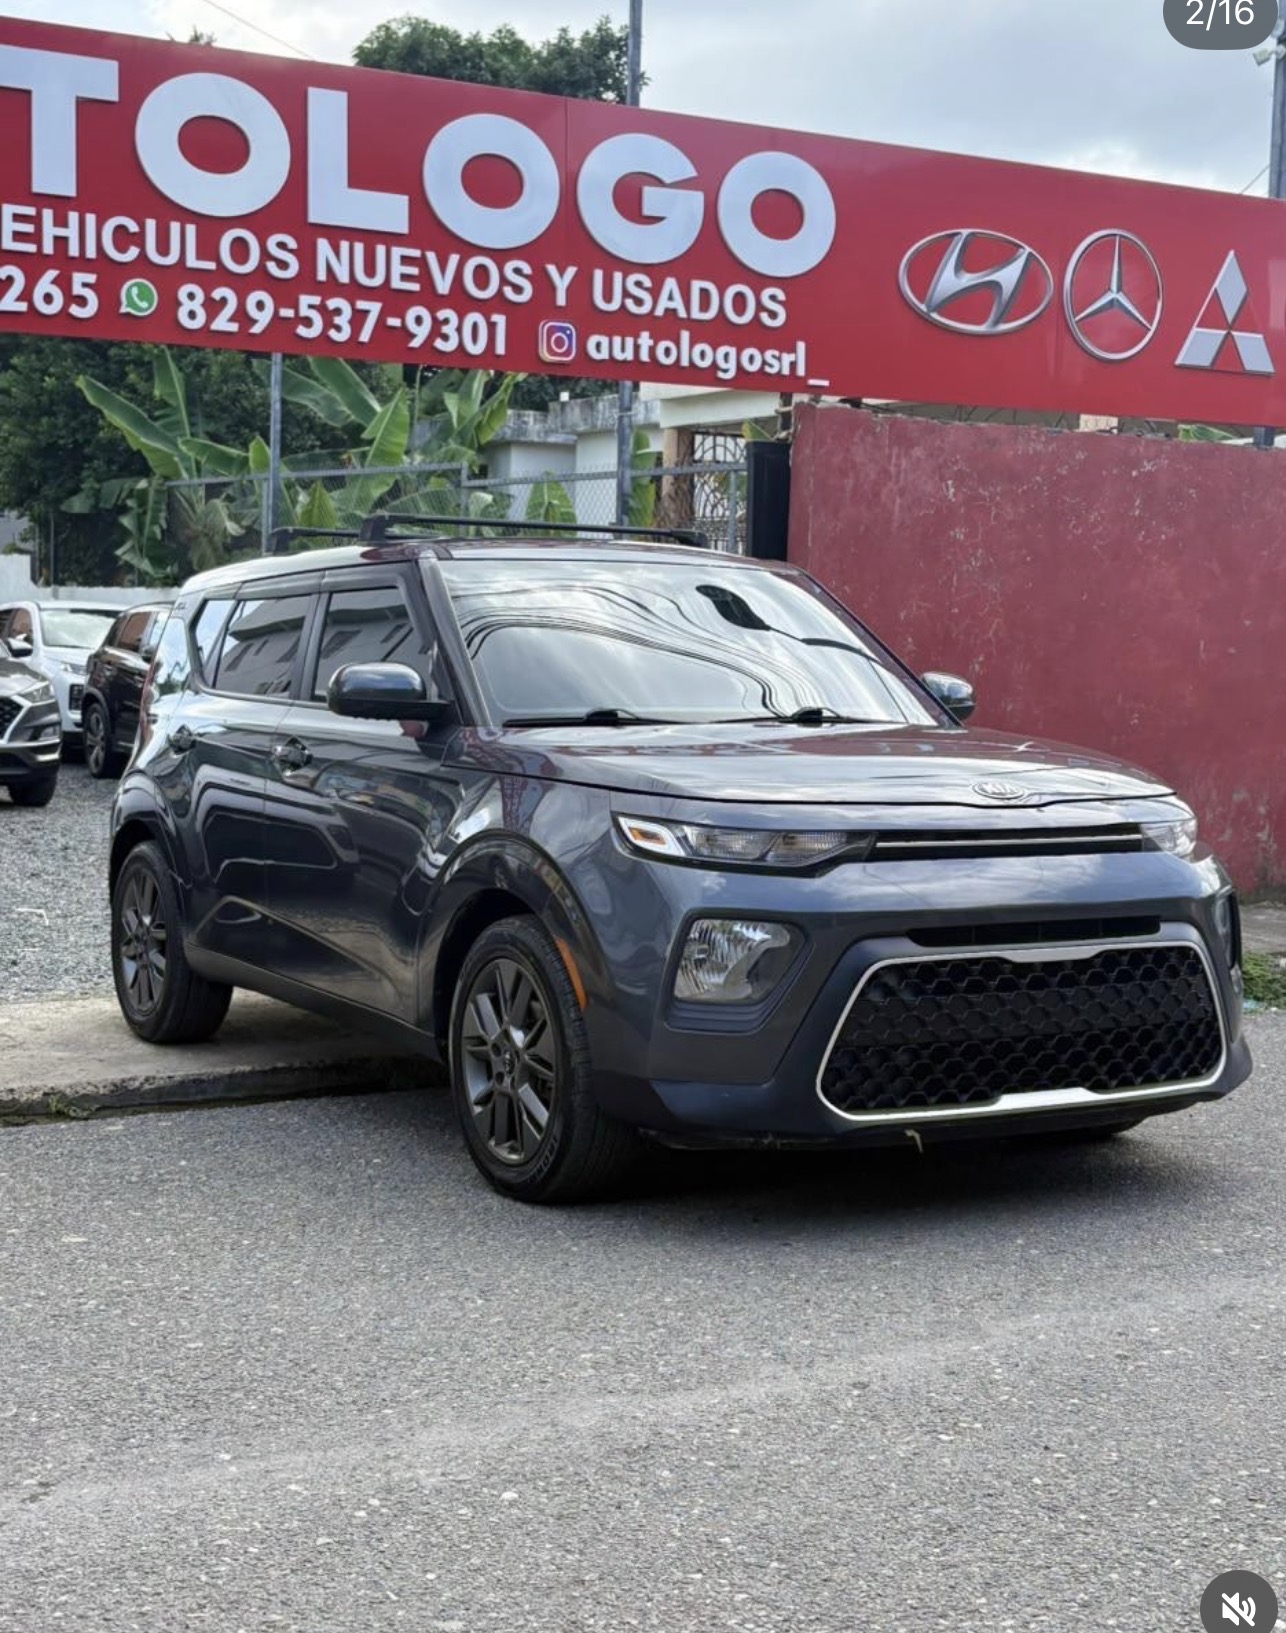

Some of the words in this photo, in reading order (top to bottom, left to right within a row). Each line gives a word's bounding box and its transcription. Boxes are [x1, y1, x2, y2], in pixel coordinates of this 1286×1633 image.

[0, 44, 837, 278] TOLOGO
[0, 264, 99, 319] 265
[177, 284, 507, 356] 829-537-9301
[586, 329, 830, 387] autologosrl_
[1, 203, 300, 279] EHICULOS
[316, 237, 533, 303] NUEVOS
[545, 263, 578, 307] Y
[592, 268, 787, 328] USADOS
